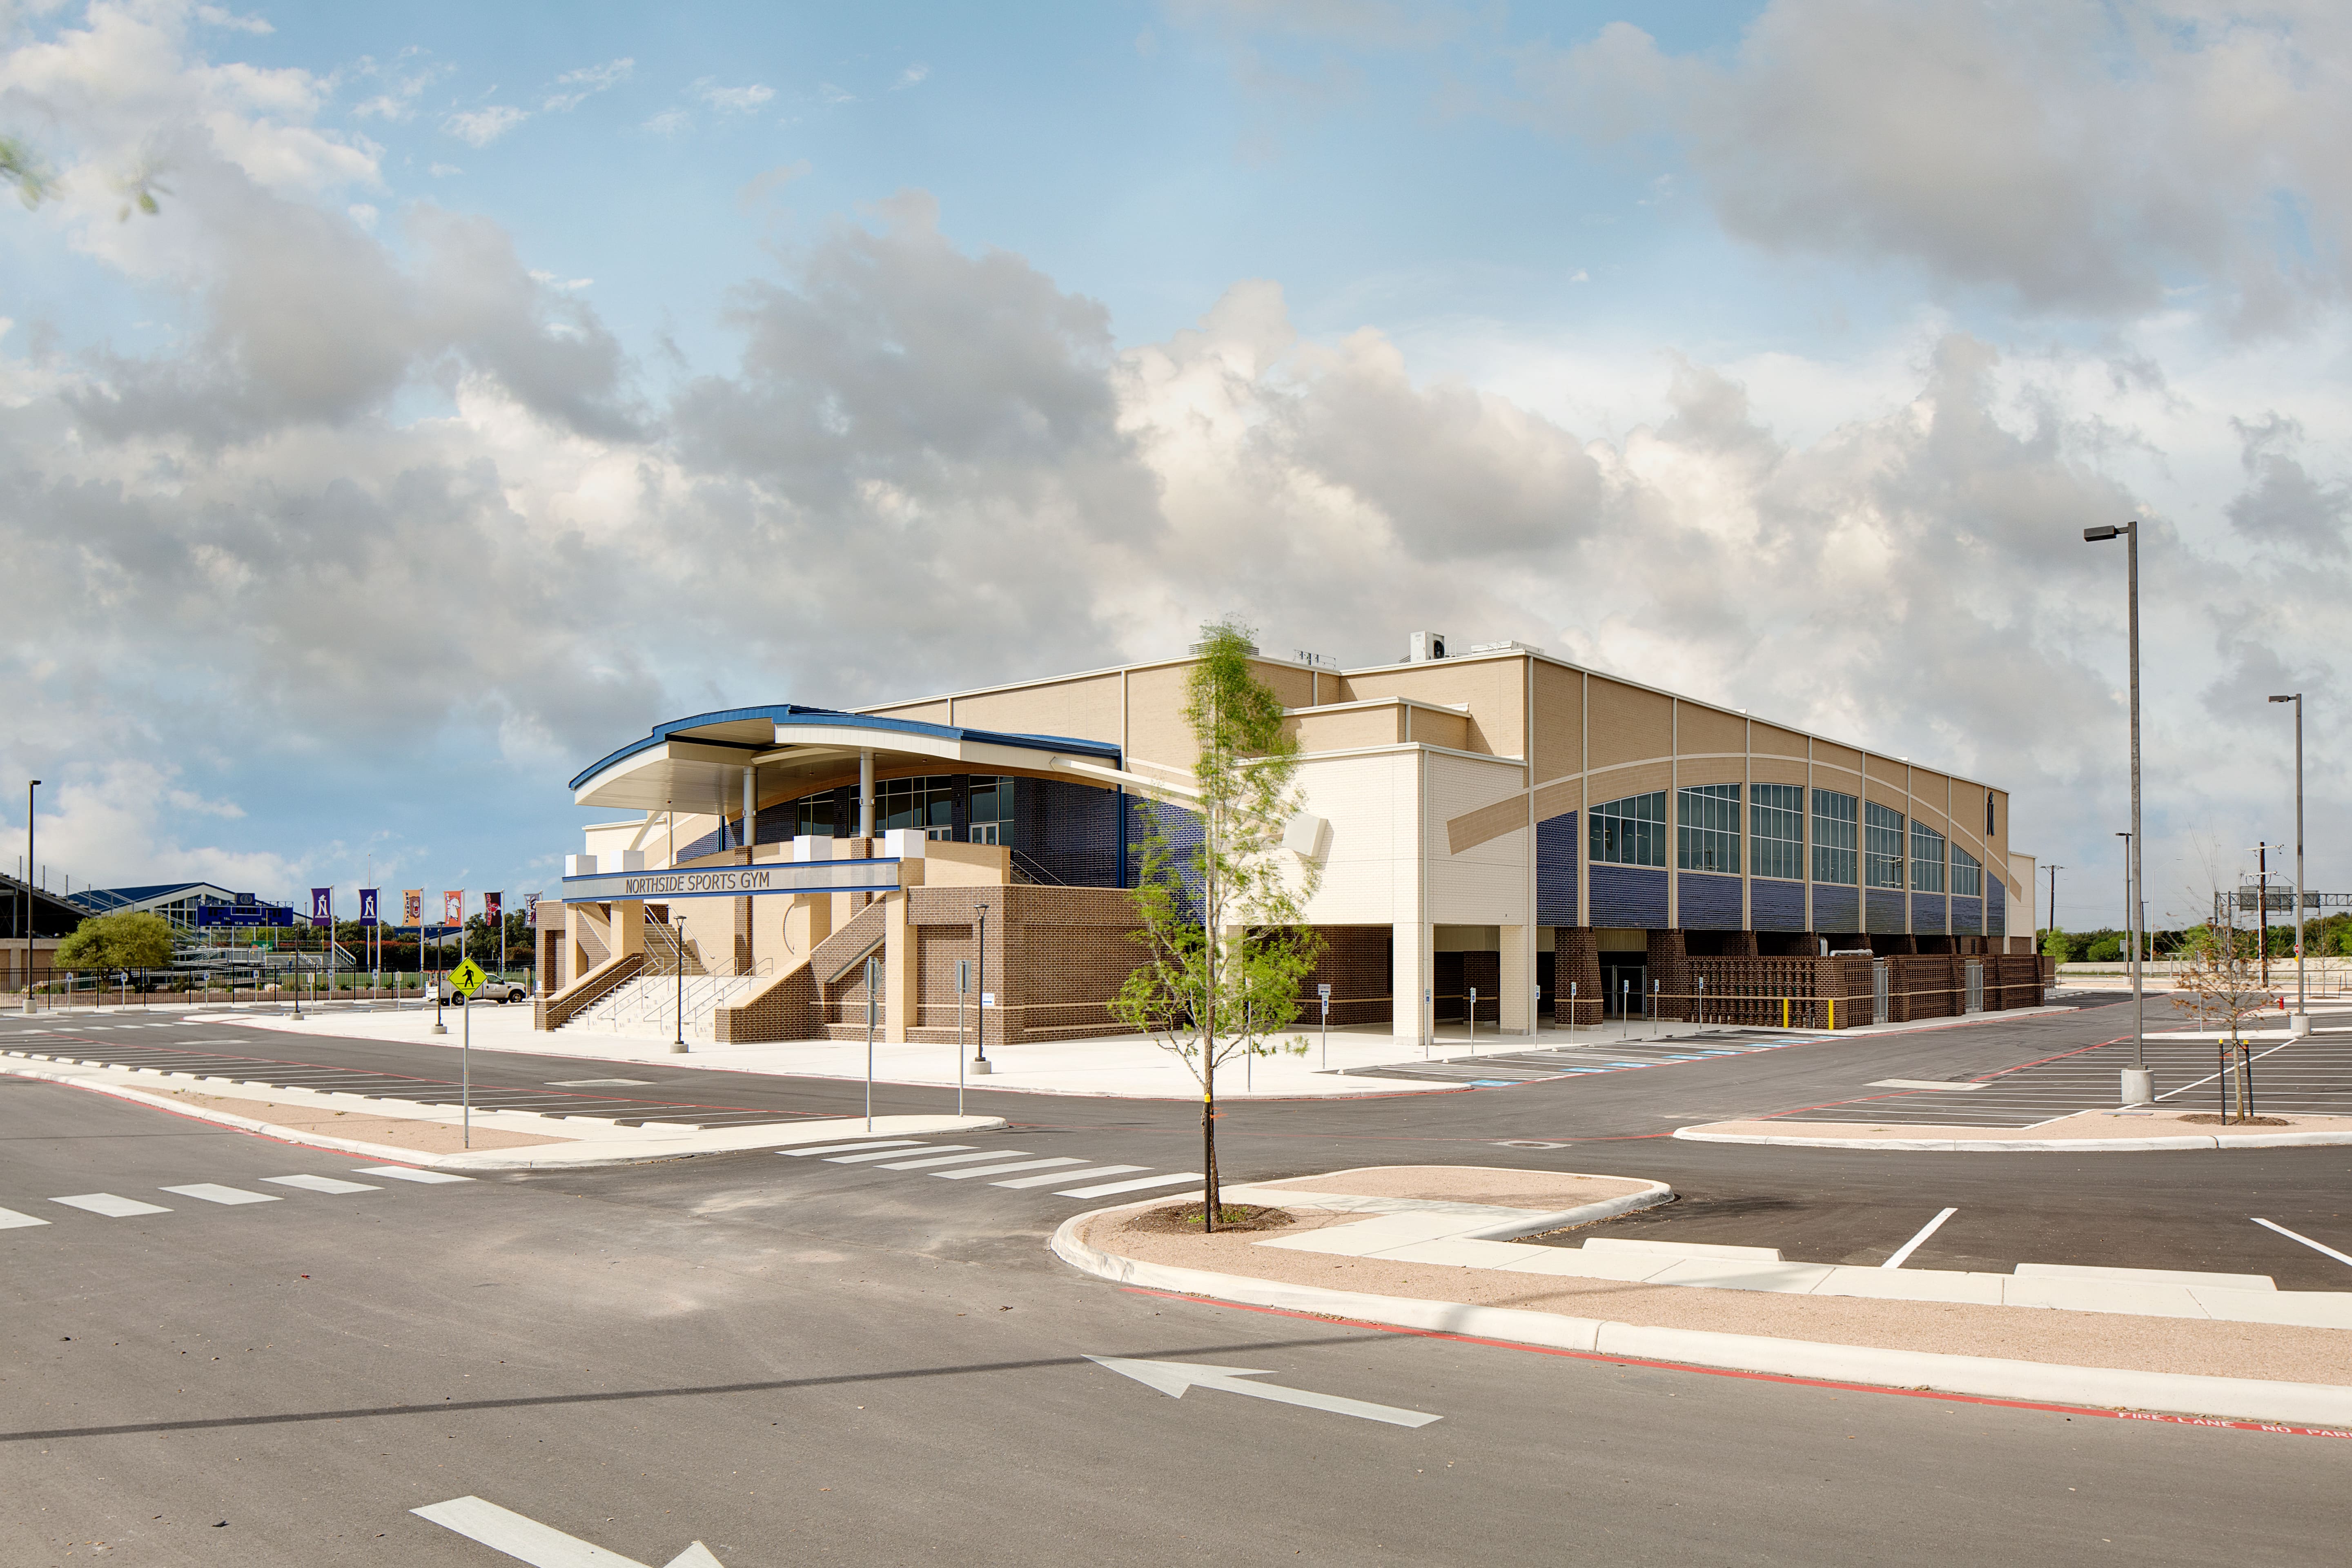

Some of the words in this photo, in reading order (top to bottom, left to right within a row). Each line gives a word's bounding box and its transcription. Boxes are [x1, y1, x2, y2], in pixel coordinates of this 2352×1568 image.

[626, 876, 684, 893] NORTHSIDE
[687, 873, 735, 891] SPORTS
[740, 871, 769, 889] GYM
[2118, 1412, 2165, 1421] FIRE
[2177, 1417, 2236, 1428] LANE
[2261, 1425, 2292, 1433] NO
